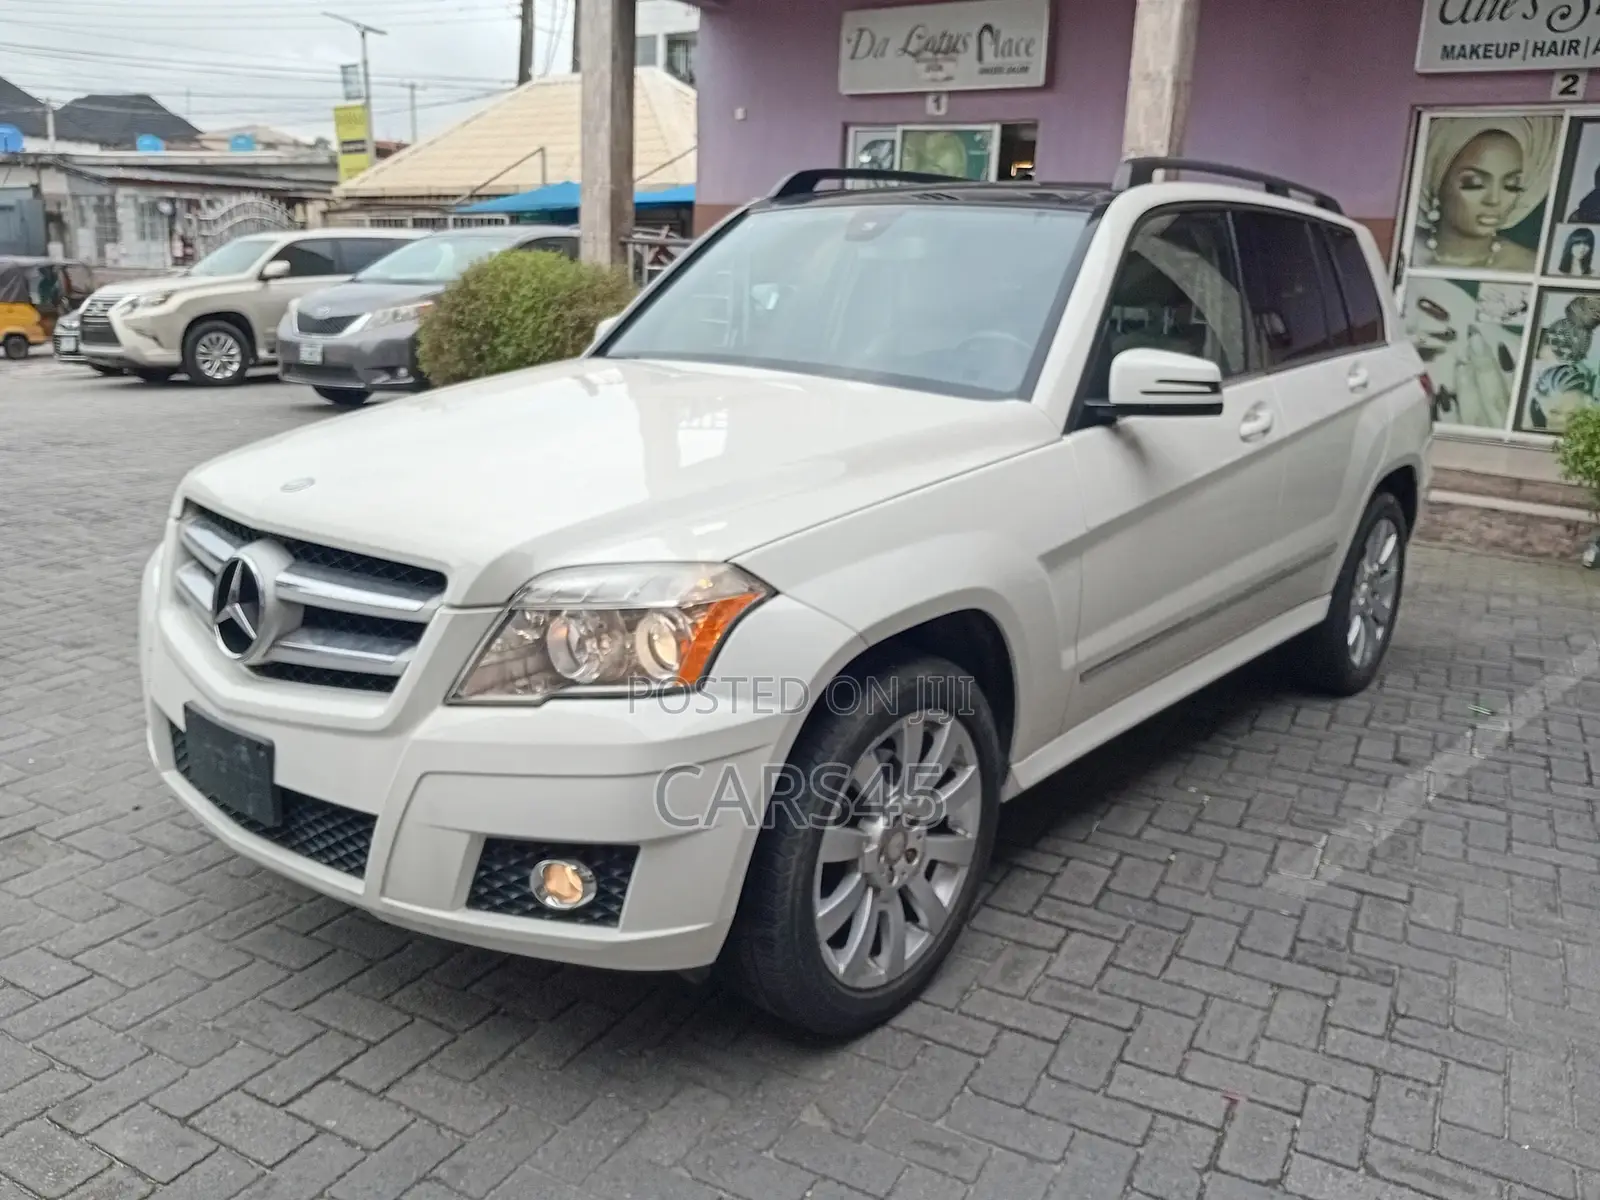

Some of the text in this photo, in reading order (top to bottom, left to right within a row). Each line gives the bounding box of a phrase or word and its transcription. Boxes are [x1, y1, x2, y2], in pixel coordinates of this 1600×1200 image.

[847, 26, 890, 60] Da
[1440, 42, 1521, 61] MAKEUP
[1531, 39, 1582, 57] HAIR
[1558, 73, 1580, 96] 2
